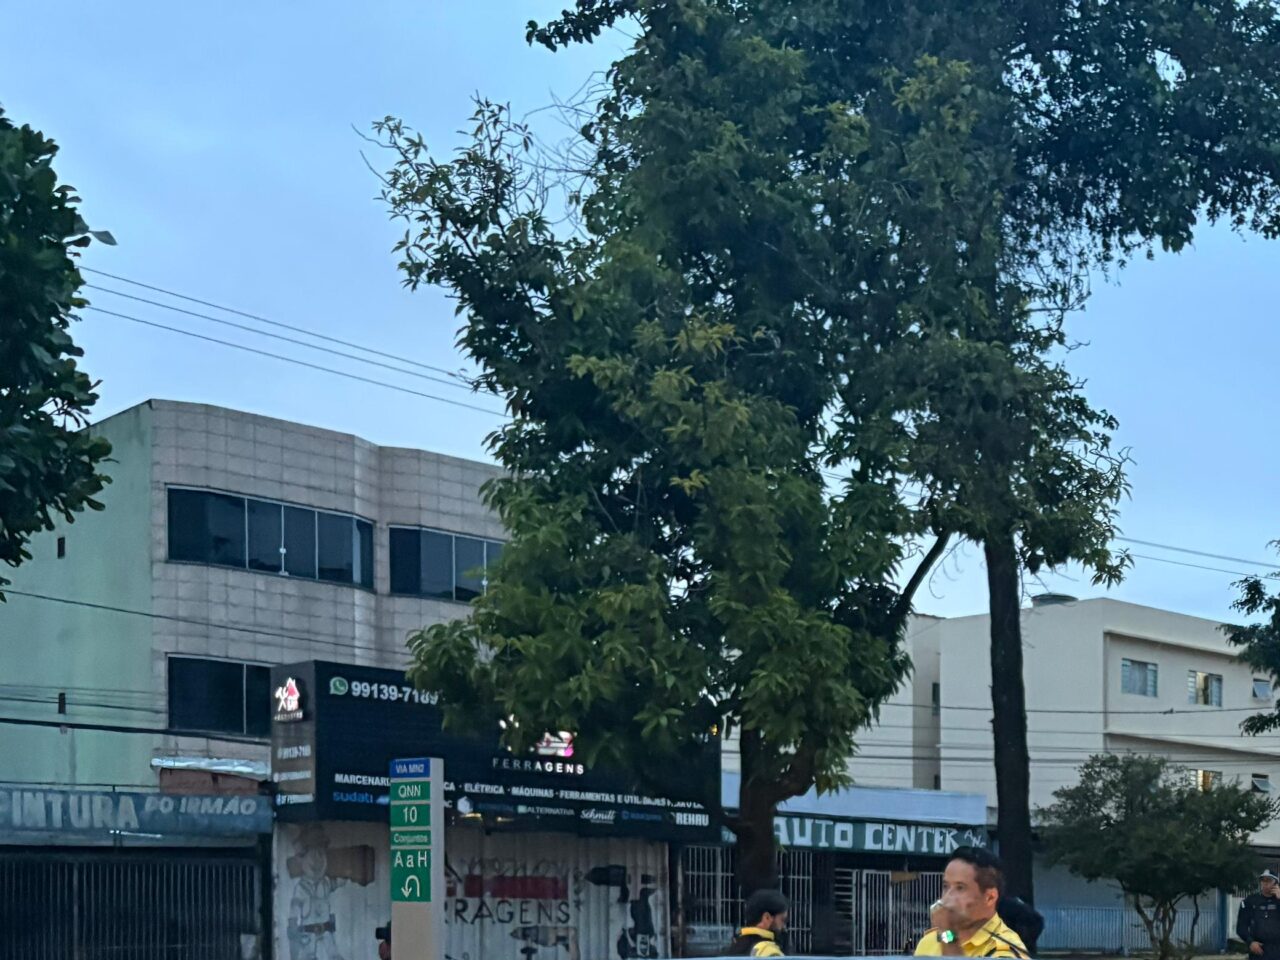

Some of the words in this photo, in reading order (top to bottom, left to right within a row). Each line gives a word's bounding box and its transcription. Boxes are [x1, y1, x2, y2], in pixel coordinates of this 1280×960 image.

[395, 764, 409, 774] VIA
[492, 757, 585, 775] FERRAGENS
[335, 773, 390, 787] MARCENARI
[464, 782, 505, 795] ELÉTRICA
[511, 785, 554, 798] MÁQUINAS
[560, 790, 616, 803] FERRAMENTAS
[398, 784, 422, 798] QNN
[403, 806, 418, 823] 10
[527, 806, 575, 816] ALTERNATIVA
[773, 816, 854, 848] AUTO
[864, 822, 960, 855] CENTER
[394, 851, 404, 868] A
[406, 854, 415, 868] a
[417, 850, 428, 868] H
[444, 898, 570, 925] RAGENS
